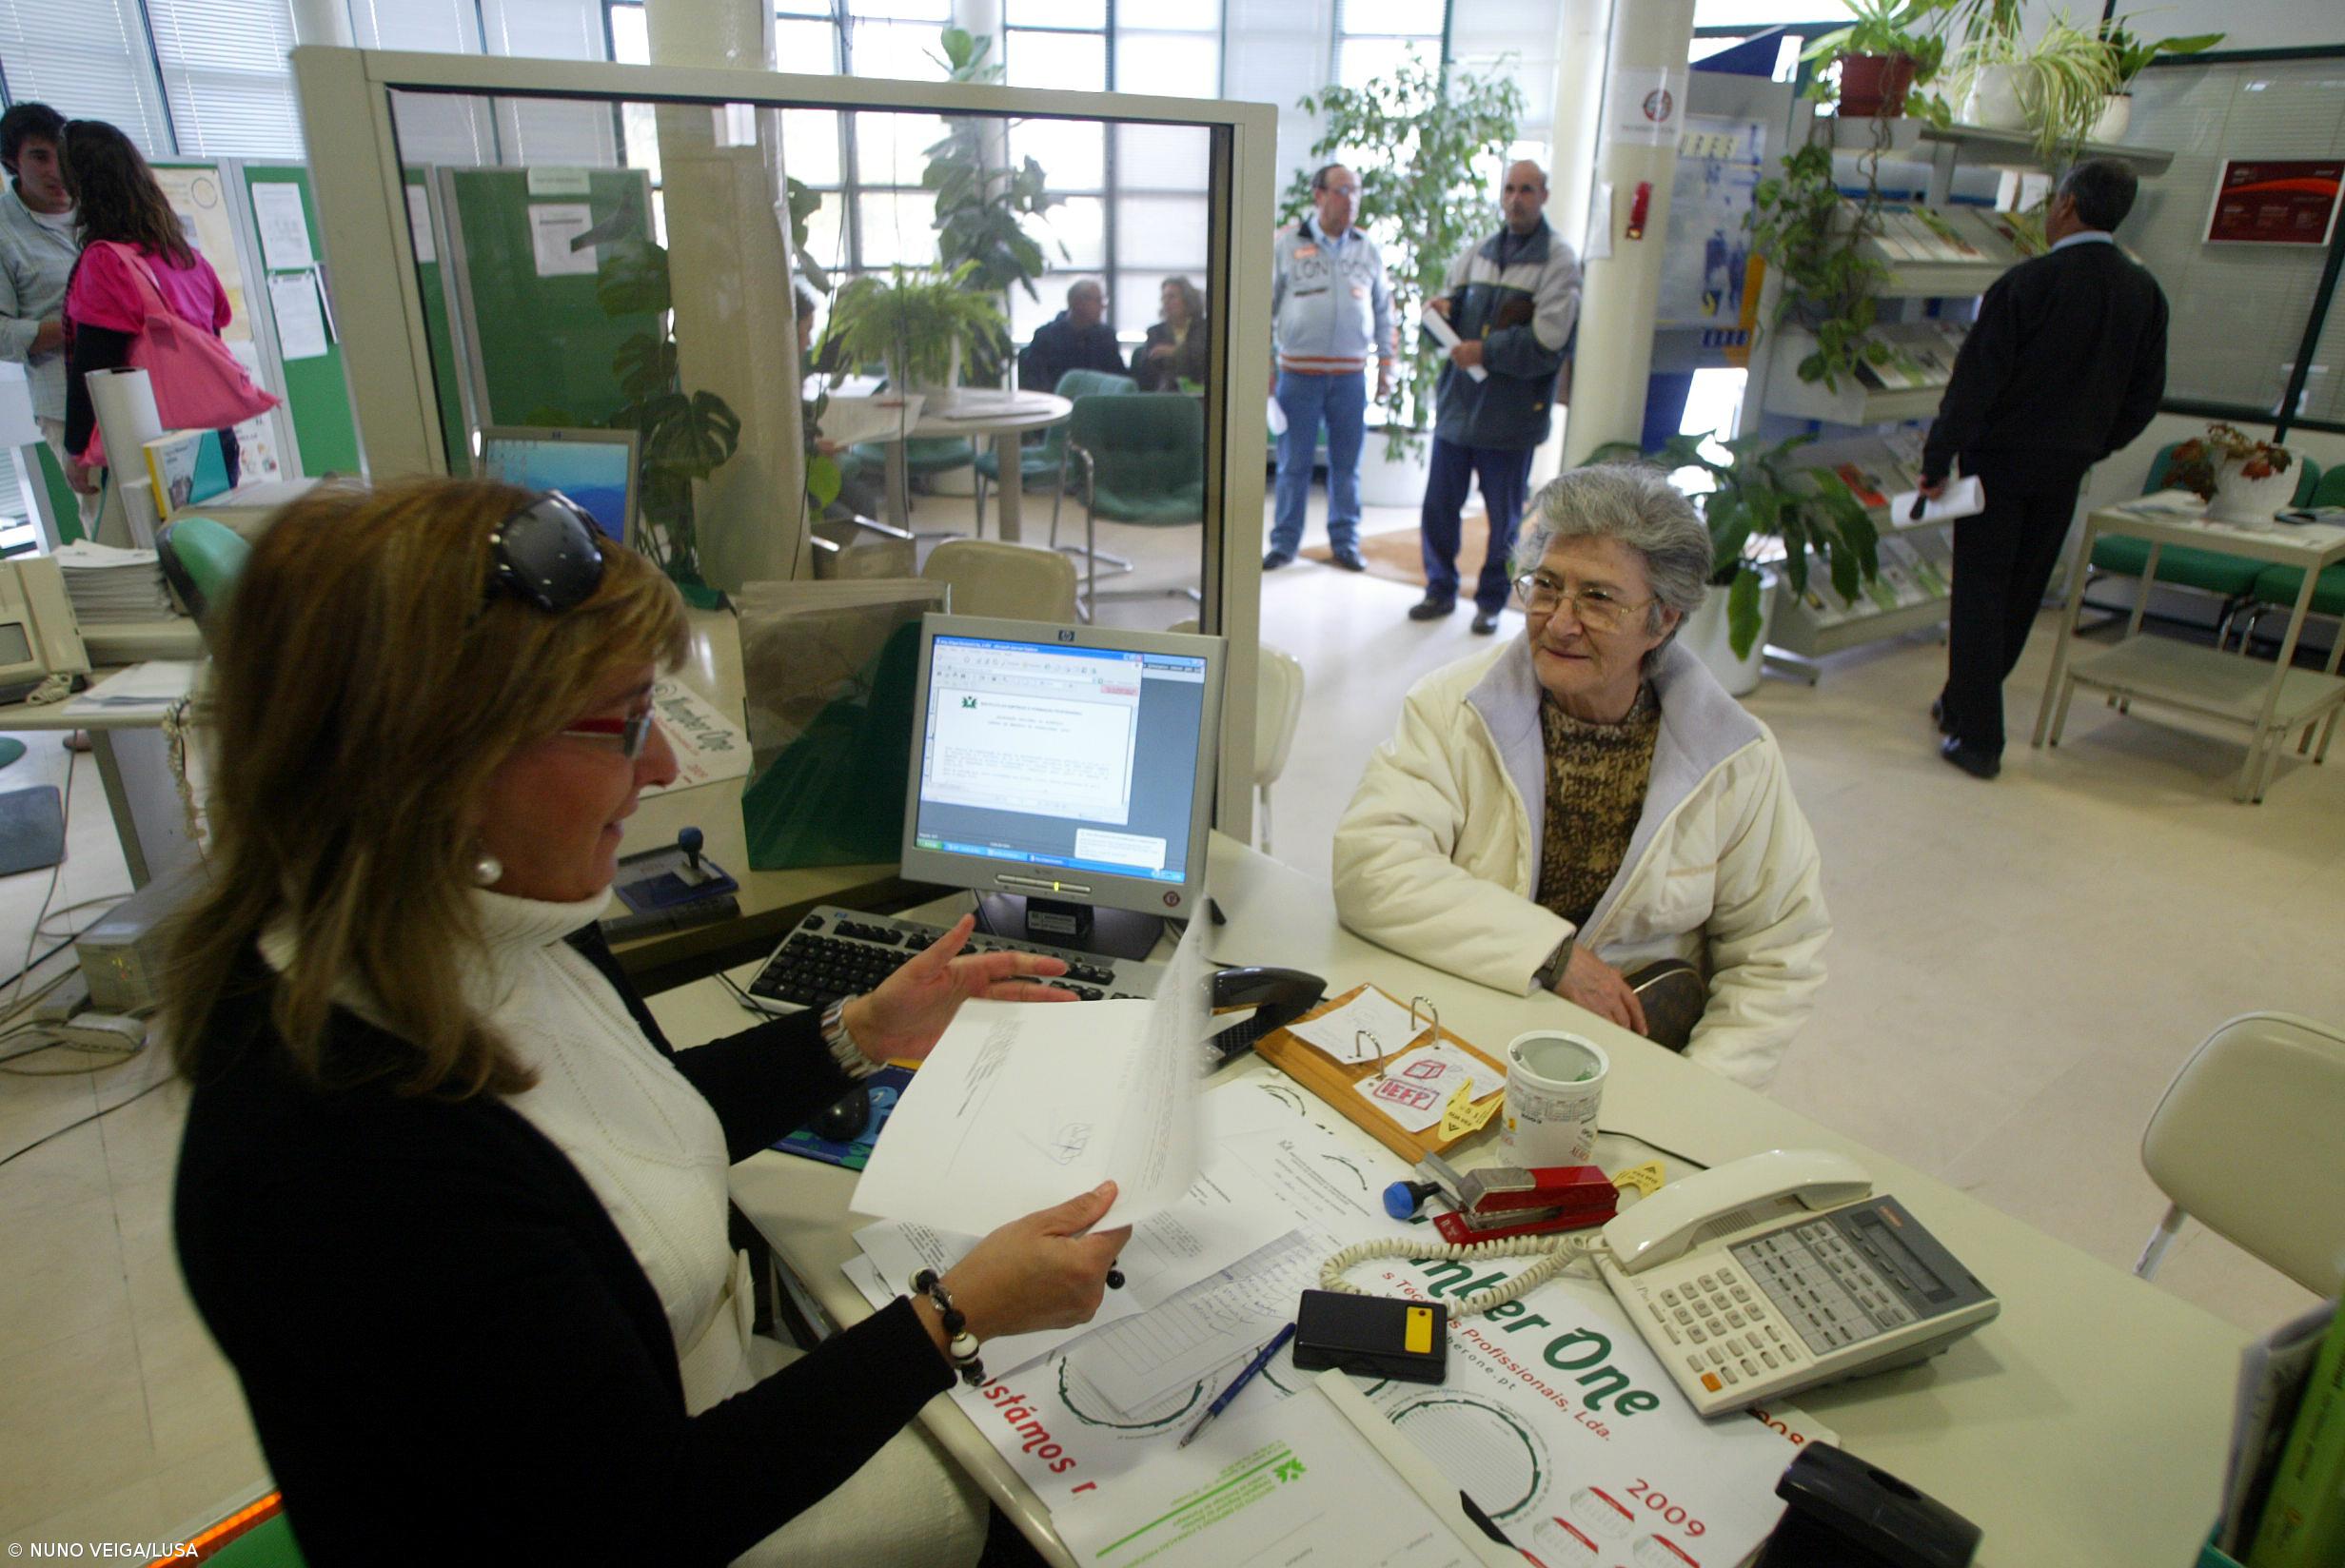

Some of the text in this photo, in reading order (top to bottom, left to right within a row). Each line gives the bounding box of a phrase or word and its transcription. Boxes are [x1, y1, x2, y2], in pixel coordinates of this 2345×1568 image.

[1380, 1079, 1432, 1107] IEFP
[1408, 1216, 1551, 1334] mber
[1543, 1326, 1660, 1418] One
[1446, 1334, 1517, 1391] berone.pt
[1462, 1328, 1568, 1412] Profissionais,
[1573, 1411, 1611, 1441] Lda.
[981, 1378, 1076, 1474] stámos
[1626, 1478, 1706, 1539] 2009
